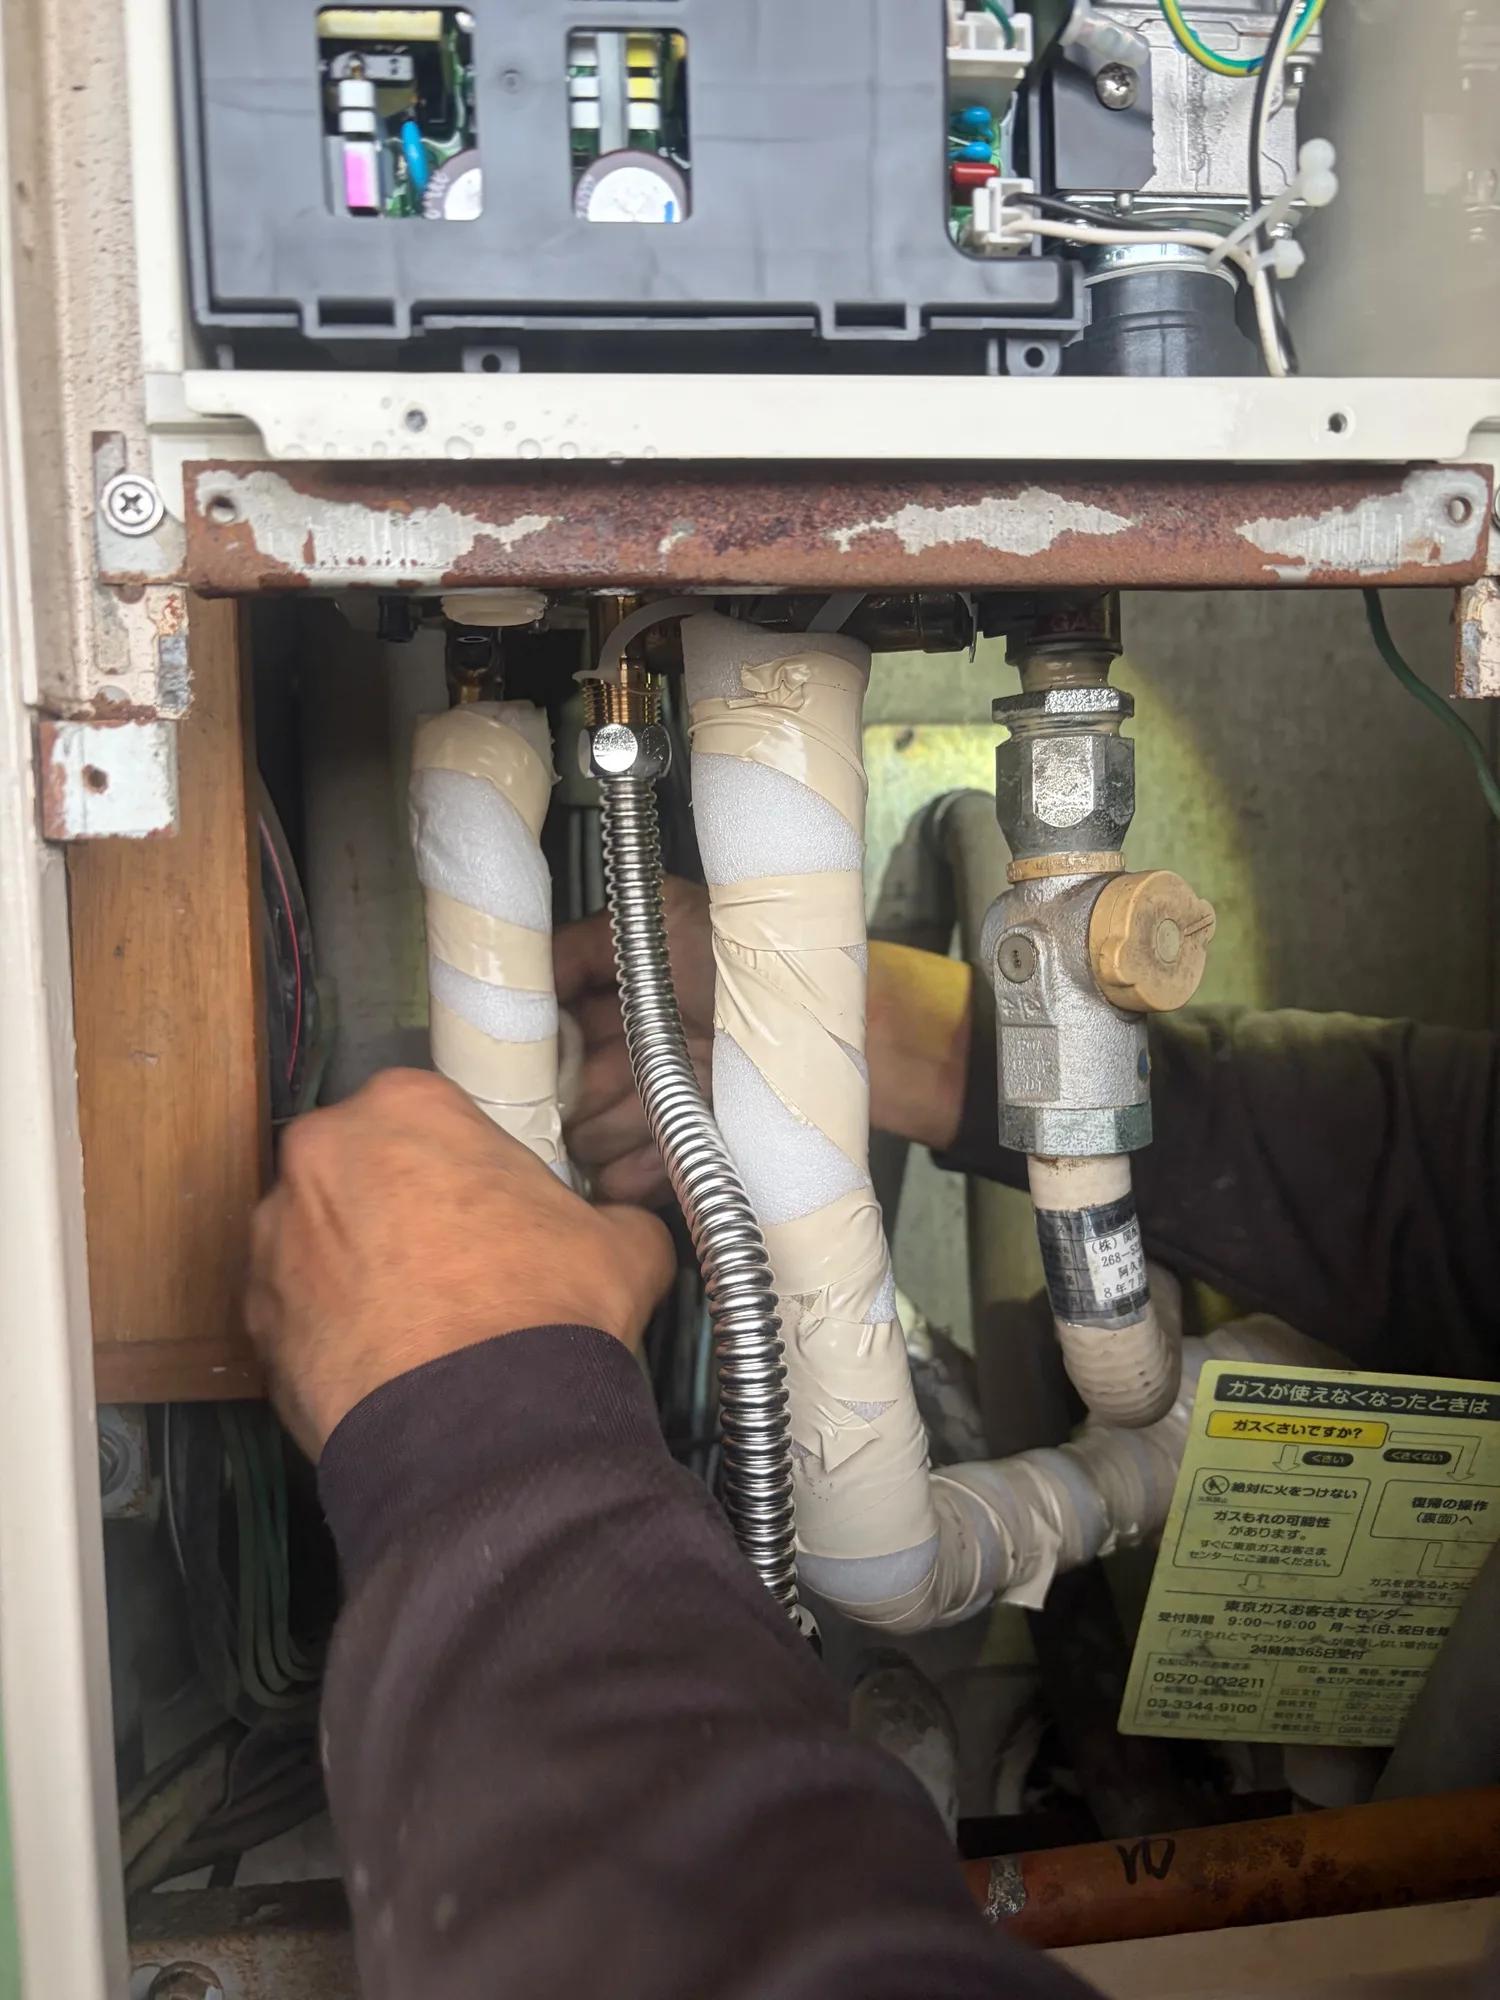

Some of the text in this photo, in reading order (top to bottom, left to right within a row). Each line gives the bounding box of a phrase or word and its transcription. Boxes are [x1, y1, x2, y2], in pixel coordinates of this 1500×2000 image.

[1226, 1380, 1490, 1414] ガスが使えなくなったときは
[1232, 1419, 1363, 1439] ガスくさいですか?
[1311, 1454, 1345, 1464] くさい
[1230, 1481, 1358, 1500] 絶対に火をつけない
[1213, 1510, 1331, 1529] ガスもれの可能性
[1228, 1526, 1307, 1541] があります。
[1153, 1671, 1265, 1688] 0570-002211
